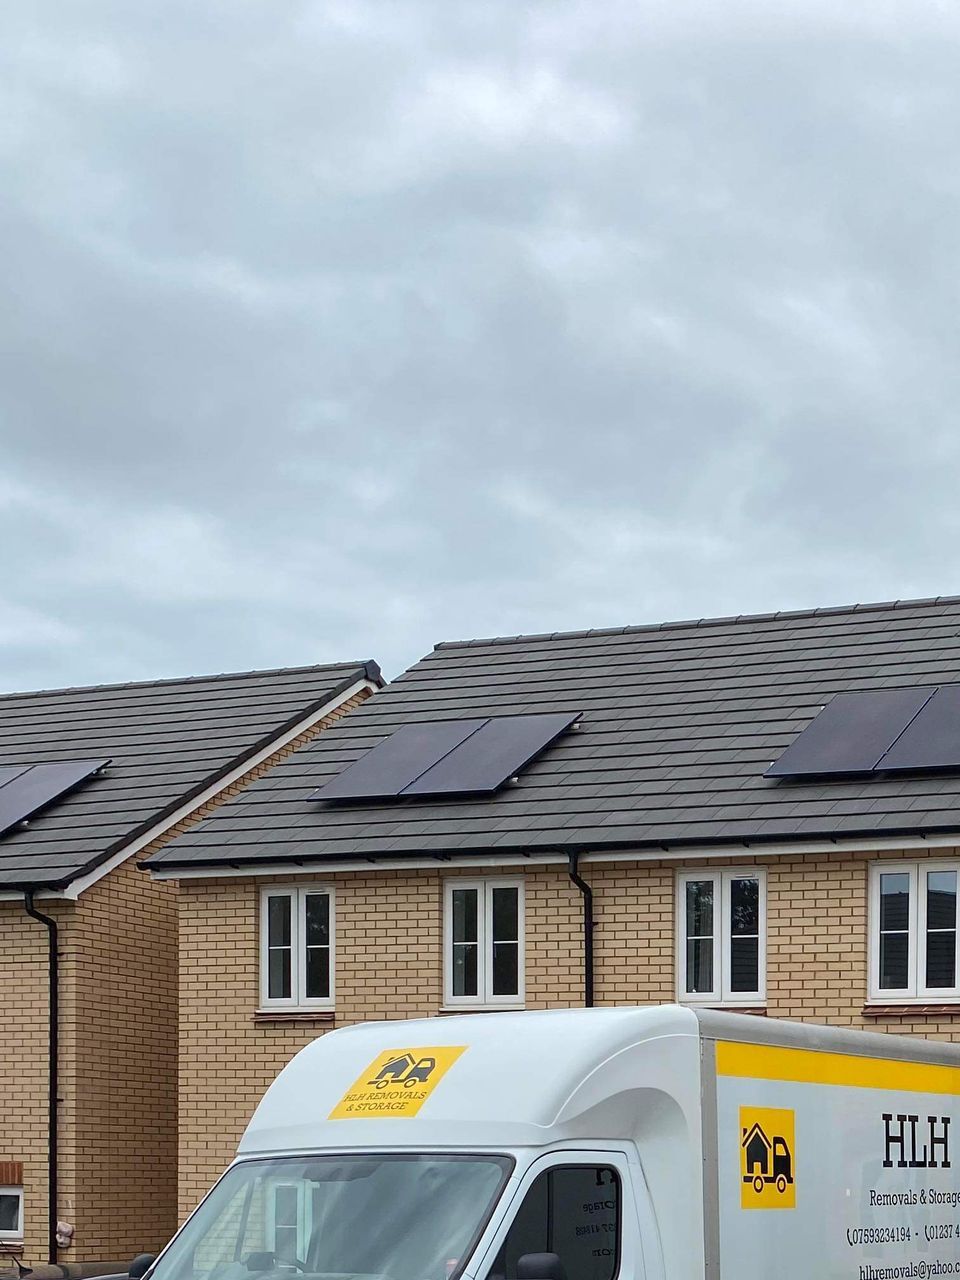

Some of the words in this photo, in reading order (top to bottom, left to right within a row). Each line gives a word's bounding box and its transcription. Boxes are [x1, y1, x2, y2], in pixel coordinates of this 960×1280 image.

[343, 1093, 366, 1102] HLH
[366, 1091, 428, 1101] REMOVALS
[345, 1103, 353, 1112] &
[355, 1101, 409, 1111] STORAGE
[882, 1113, 951, 1168] HLH
[869, 1189, 918, 1206] Removals
[919, 1188, 927, 1205] &
[852, 1227, 911, 1244] 07593234194
[929, 1224, 953, 1241] 01237
